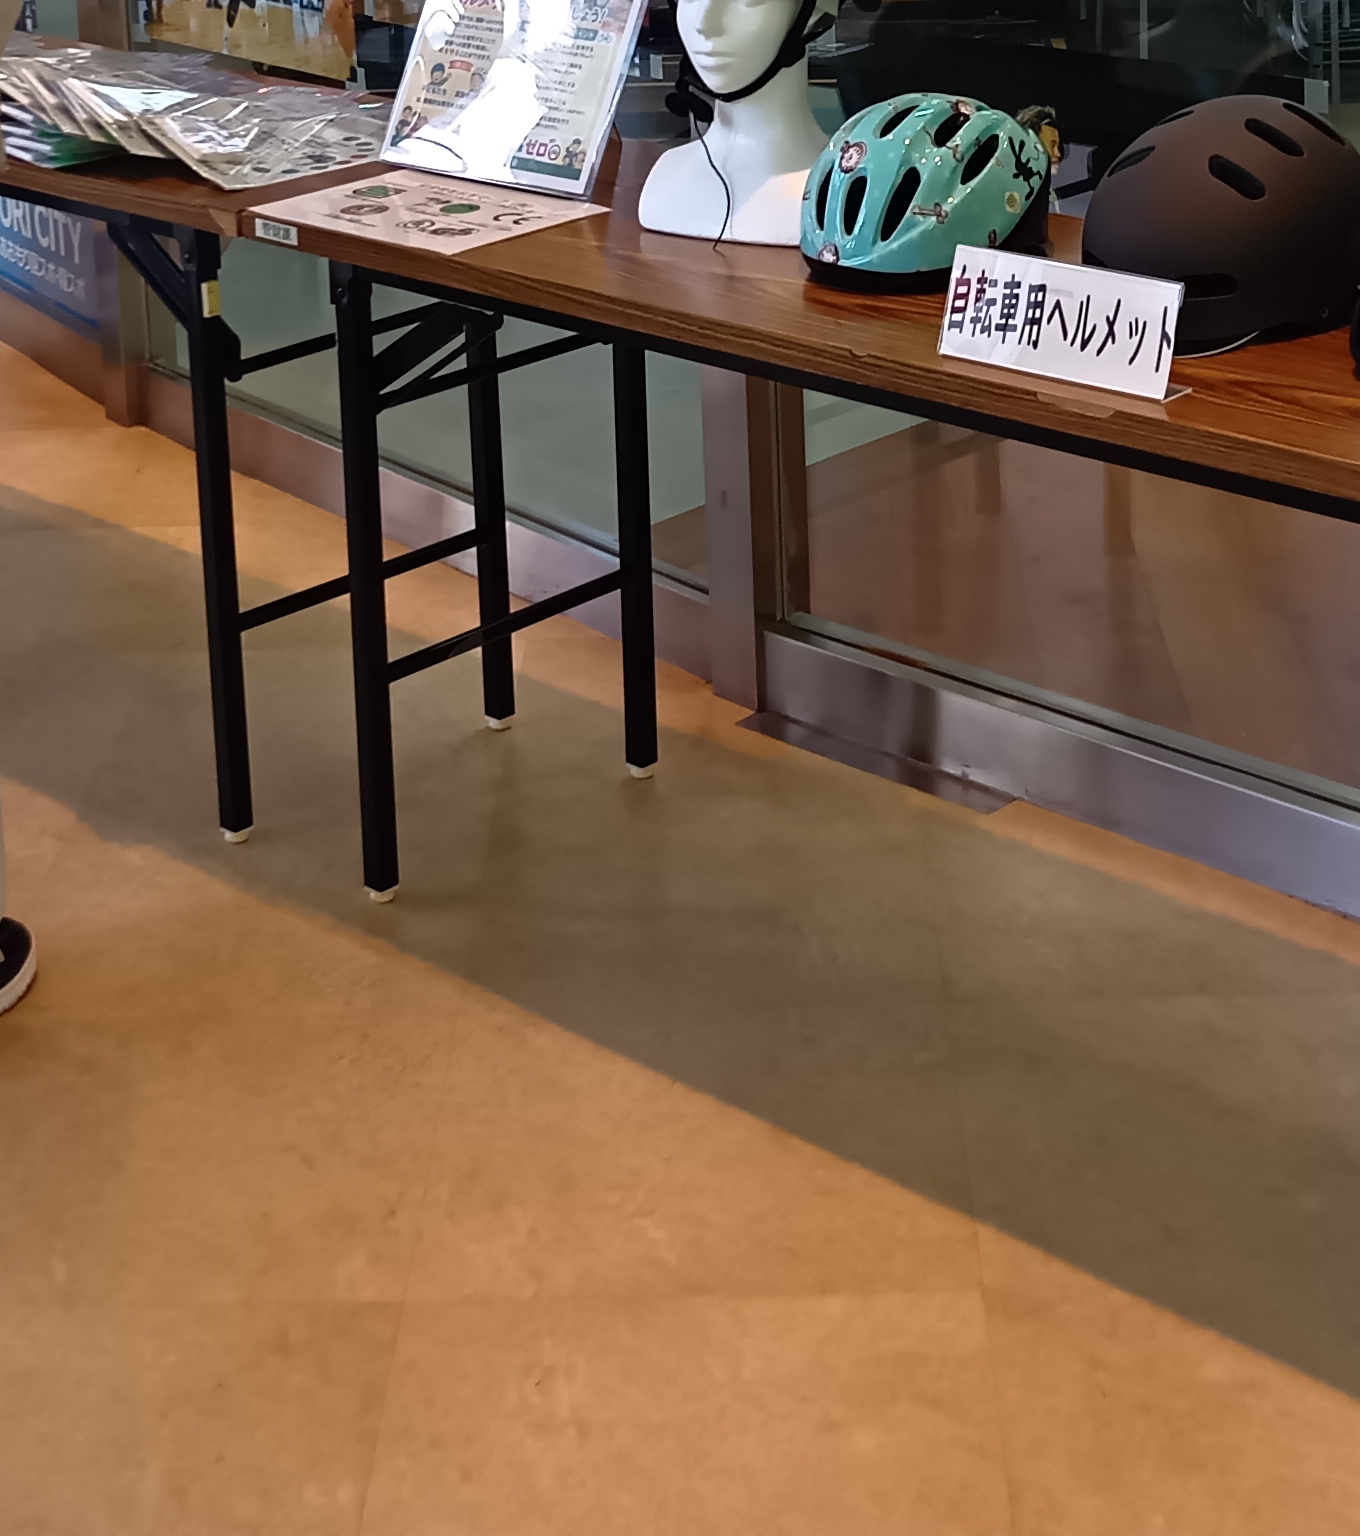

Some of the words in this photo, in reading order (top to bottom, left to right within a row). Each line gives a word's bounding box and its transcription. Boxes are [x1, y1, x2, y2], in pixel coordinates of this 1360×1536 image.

[34, 206, 82, 264] CITY
[946, 264, 1173, 373] 自転車用ヘルメット
